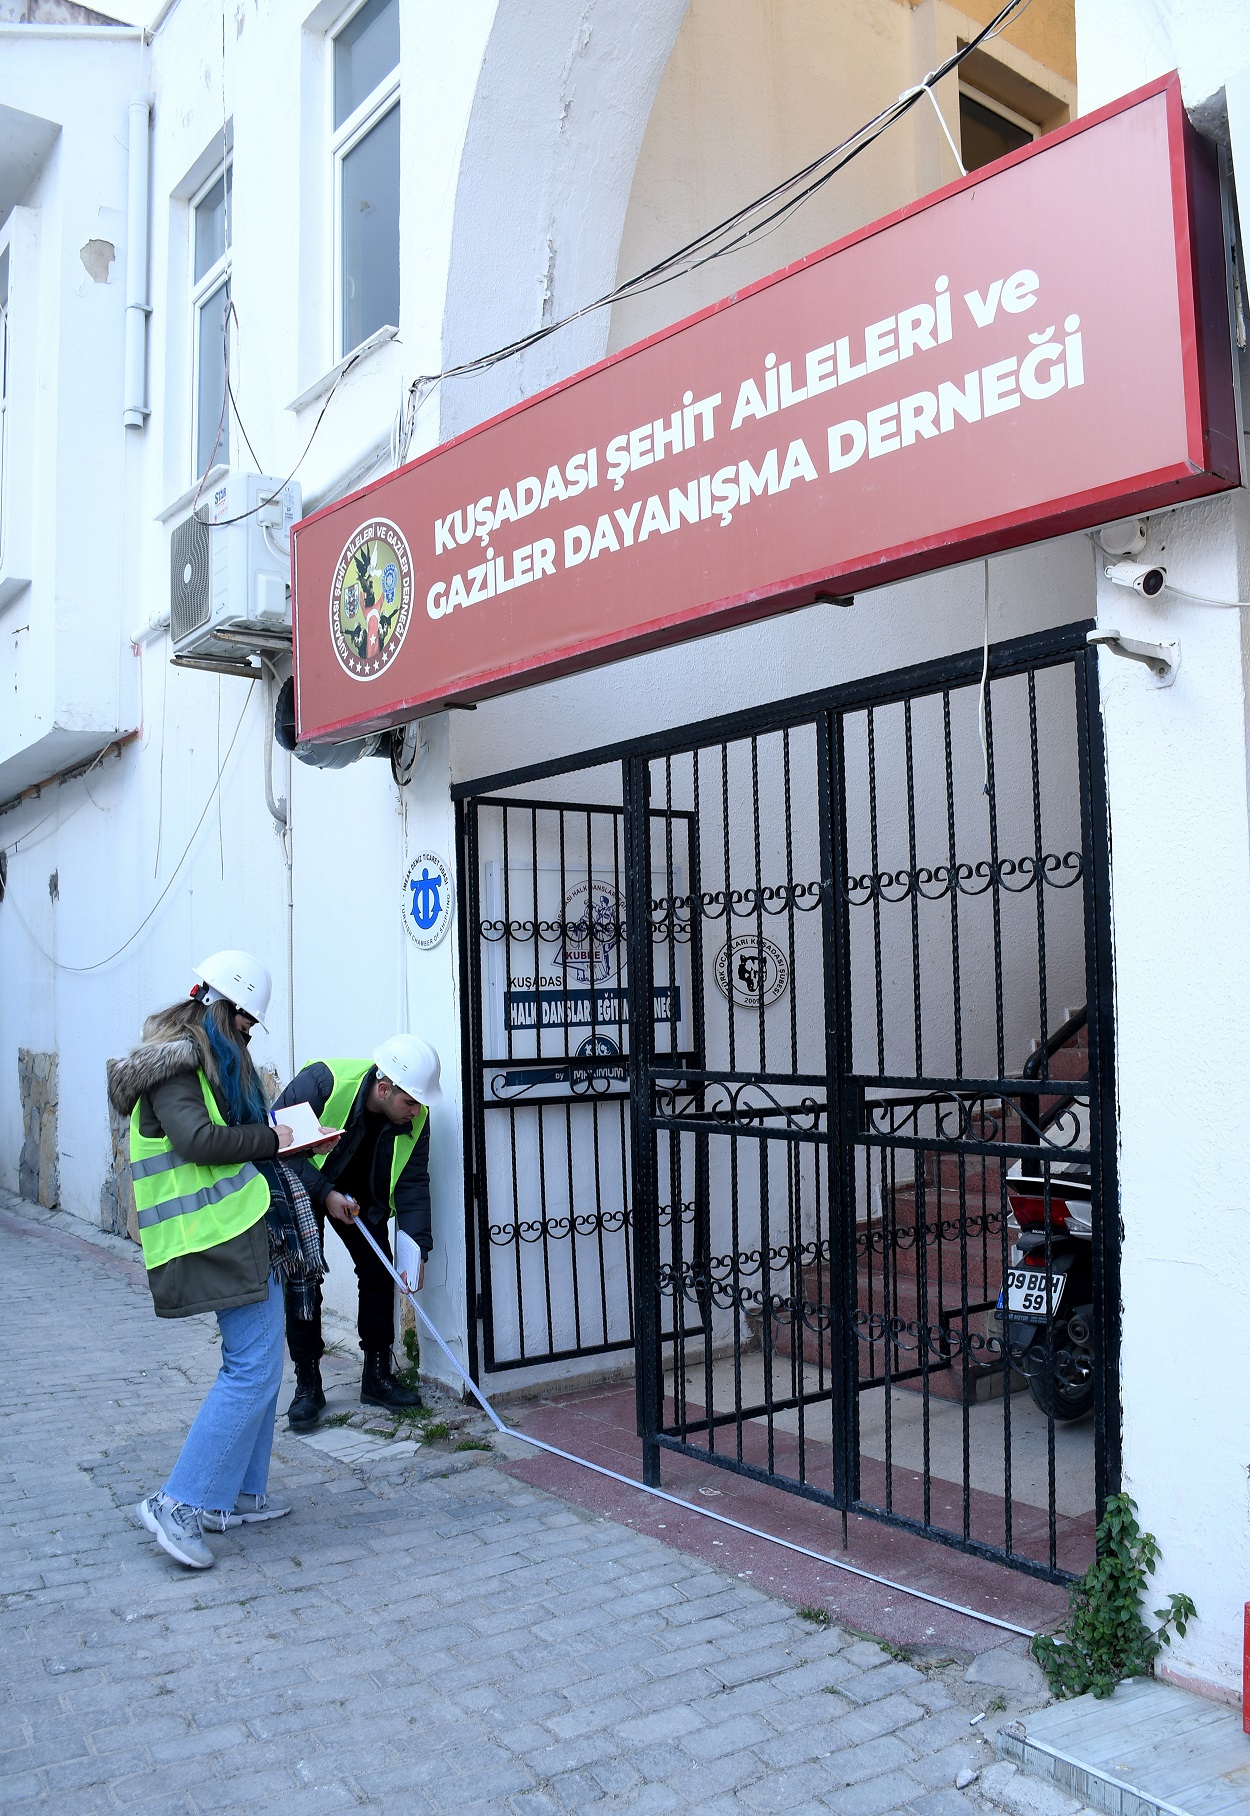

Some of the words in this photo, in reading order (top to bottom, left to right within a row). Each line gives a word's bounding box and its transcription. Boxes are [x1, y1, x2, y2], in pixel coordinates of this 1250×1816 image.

[434, 446, 598, 556] KUŞADASI
[606, 390, 722, 492] ŞEHİT
[730, 274, 953, 431] AİLELERİ
[963, 268, 1040, 329] ve
[426, 547, 557, 620] GAZİLER
[563, 438, 819, 569] DAYANIŞMA
[828, 313, 1085, 473] DERNEĞİ
[346, 523, 375, 562] AİLELERİ
[376, 525, 387, 539] VE
[387, 530, 409, 575] GAZİLER
[334, 560, 347, 597] ŞEHİT
[395, 576, 410, 640] DERNEĞİ
[333, 600, 349, 660] KUŞADASI
[411, 935, 434, 947] CHAMBER
[433, 931, 440, 942] OF
[718, 938, 748, 969] OCALARI
[555, 1072, 565, 1081] by
[1006, 1271, 1027, 1290] 09
